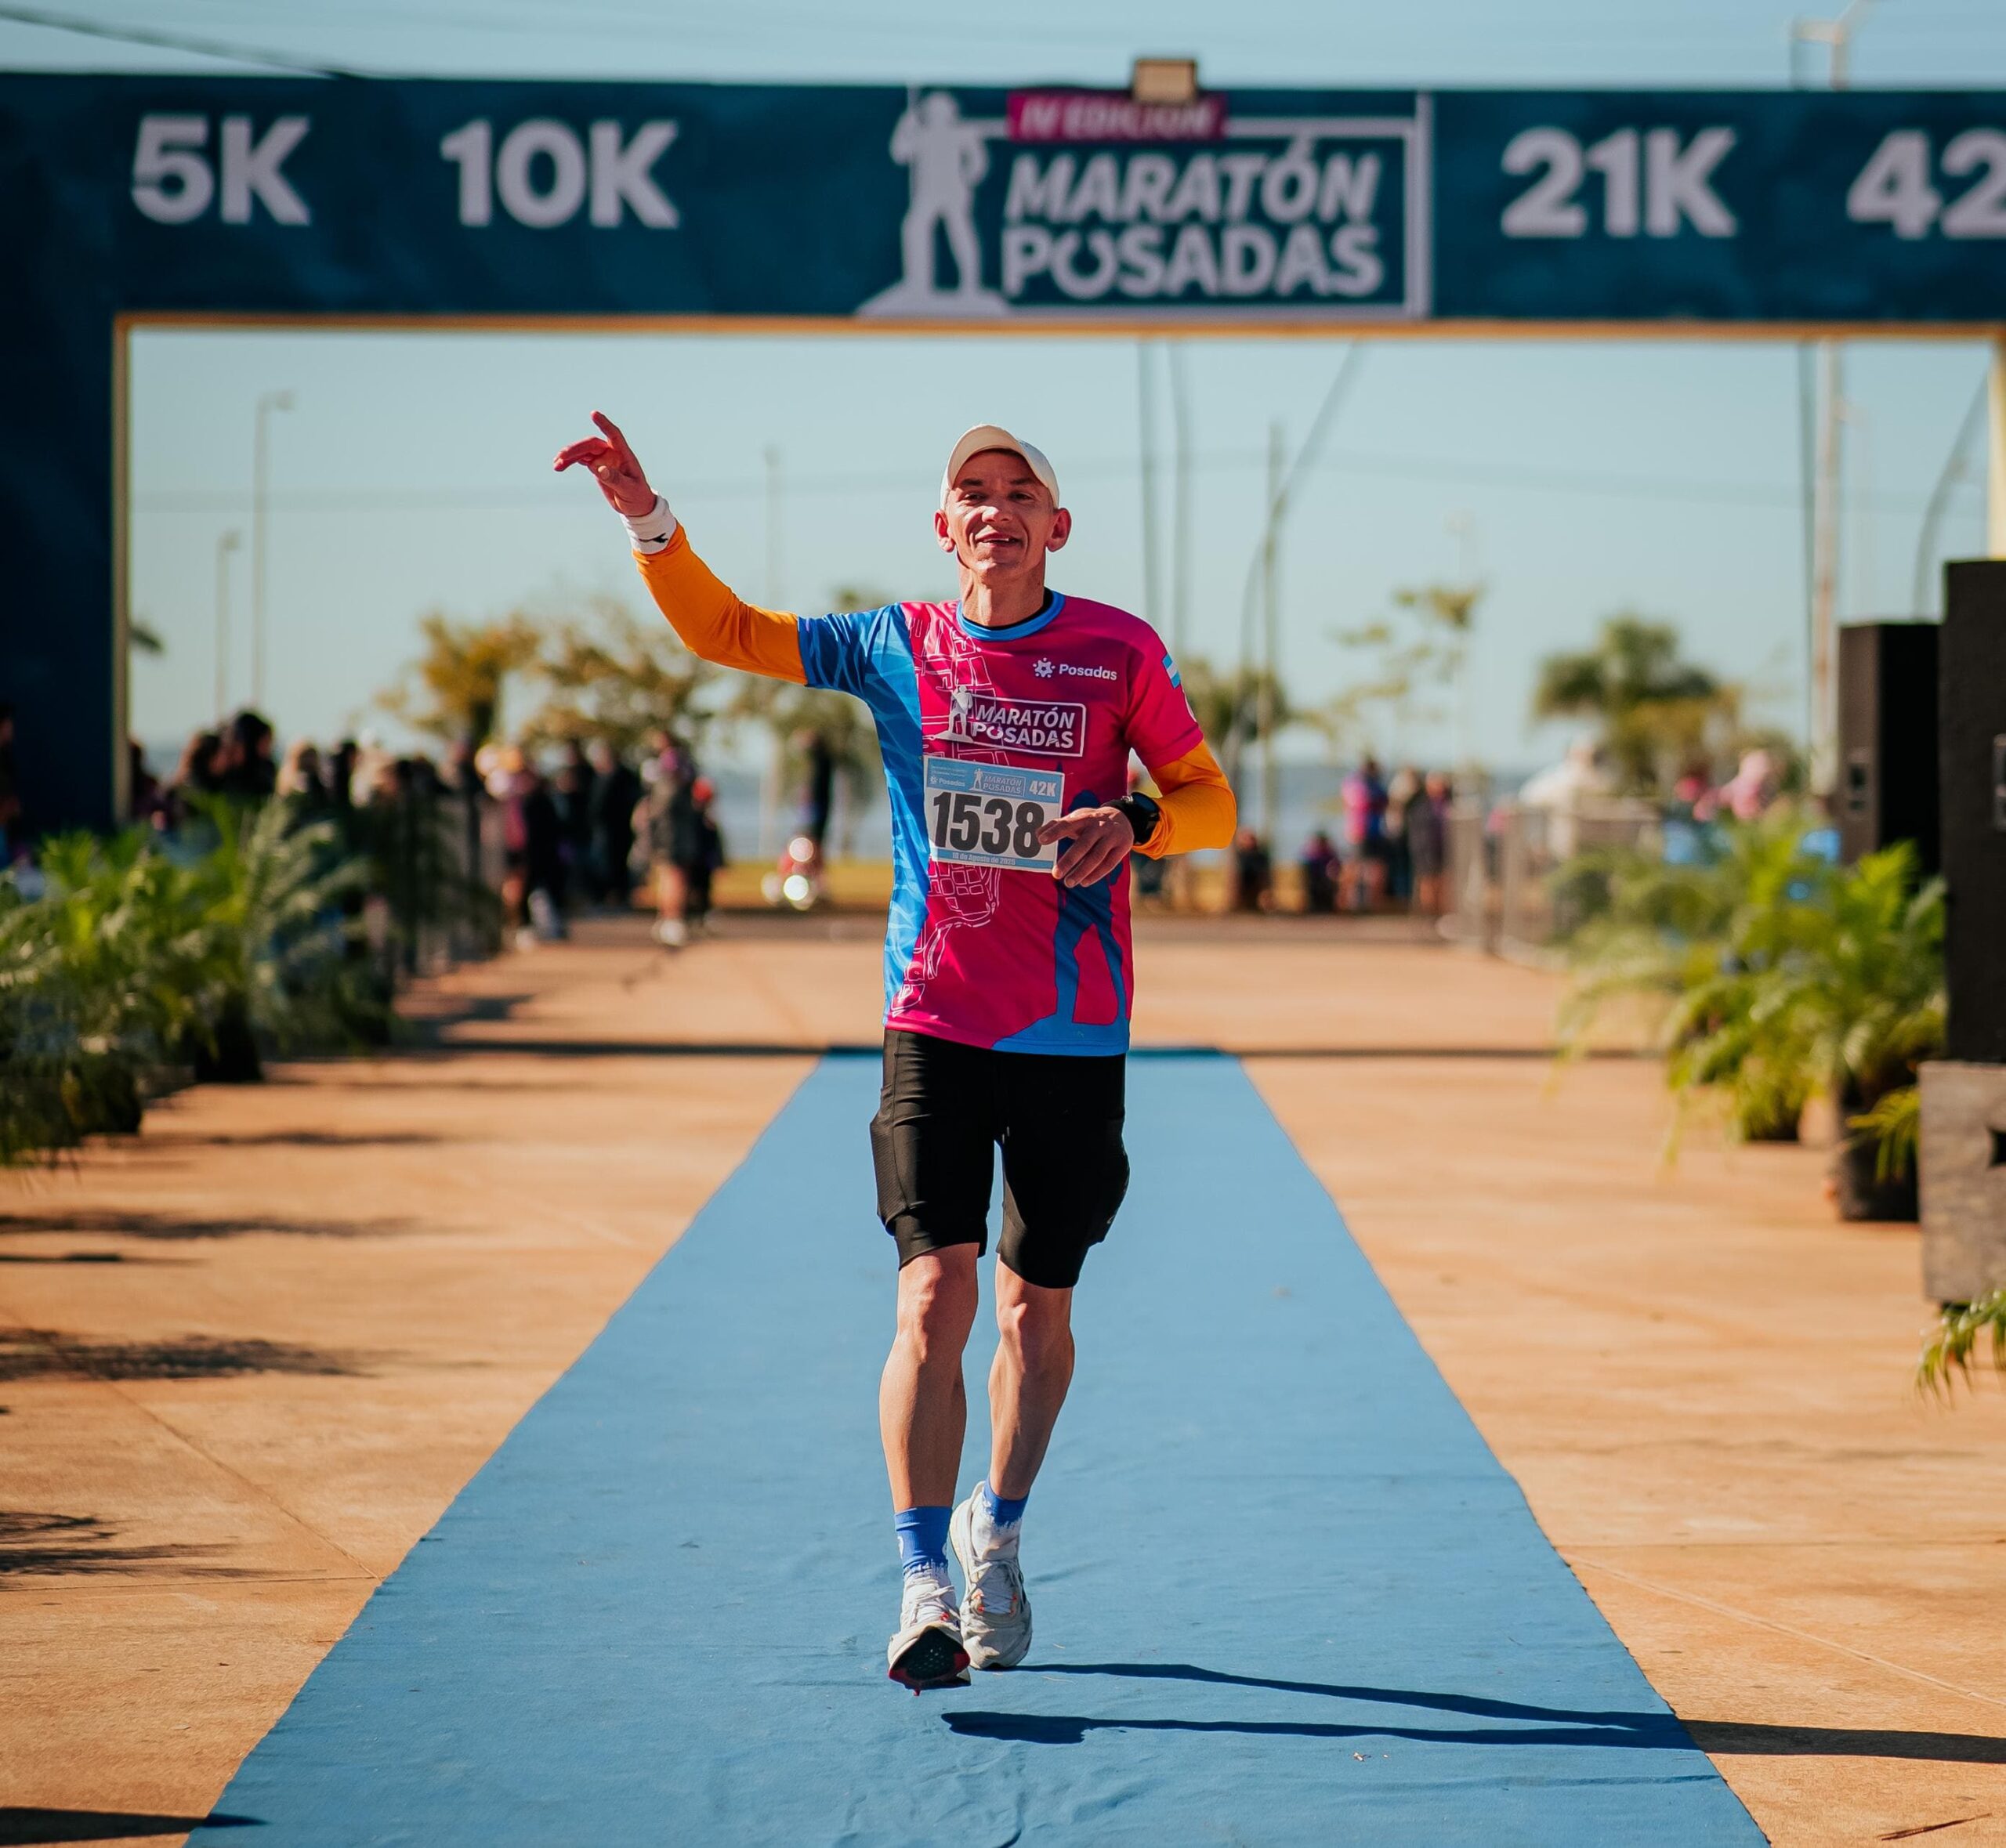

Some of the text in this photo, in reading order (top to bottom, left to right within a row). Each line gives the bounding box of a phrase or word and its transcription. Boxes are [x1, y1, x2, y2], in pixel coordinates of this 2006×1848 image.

[1019, 99, 1058, 138] IV
[131, 114, 312, 226] 5K
[441, 118, 680, 229] 10K
[1005, 129, 1381, 223] MARATÓN
[1500, 126, 1737, 237] 21K
[1002, 225, 1385, 298] POSADAS
[1059, 664, 1117, 681] Posadas
[976, 704, 1076, 729] MARATÓN
[972, 721, 1074, 749] POSADAS
[939, 778, 966, 787] Posadas
[983, 774, 1023, 787] MARATÓN
[983, 783, 1022, 794] POSADAS
[1029, 780, 1057, 797] 42K
[933, 792, 1045, 859] 1538
